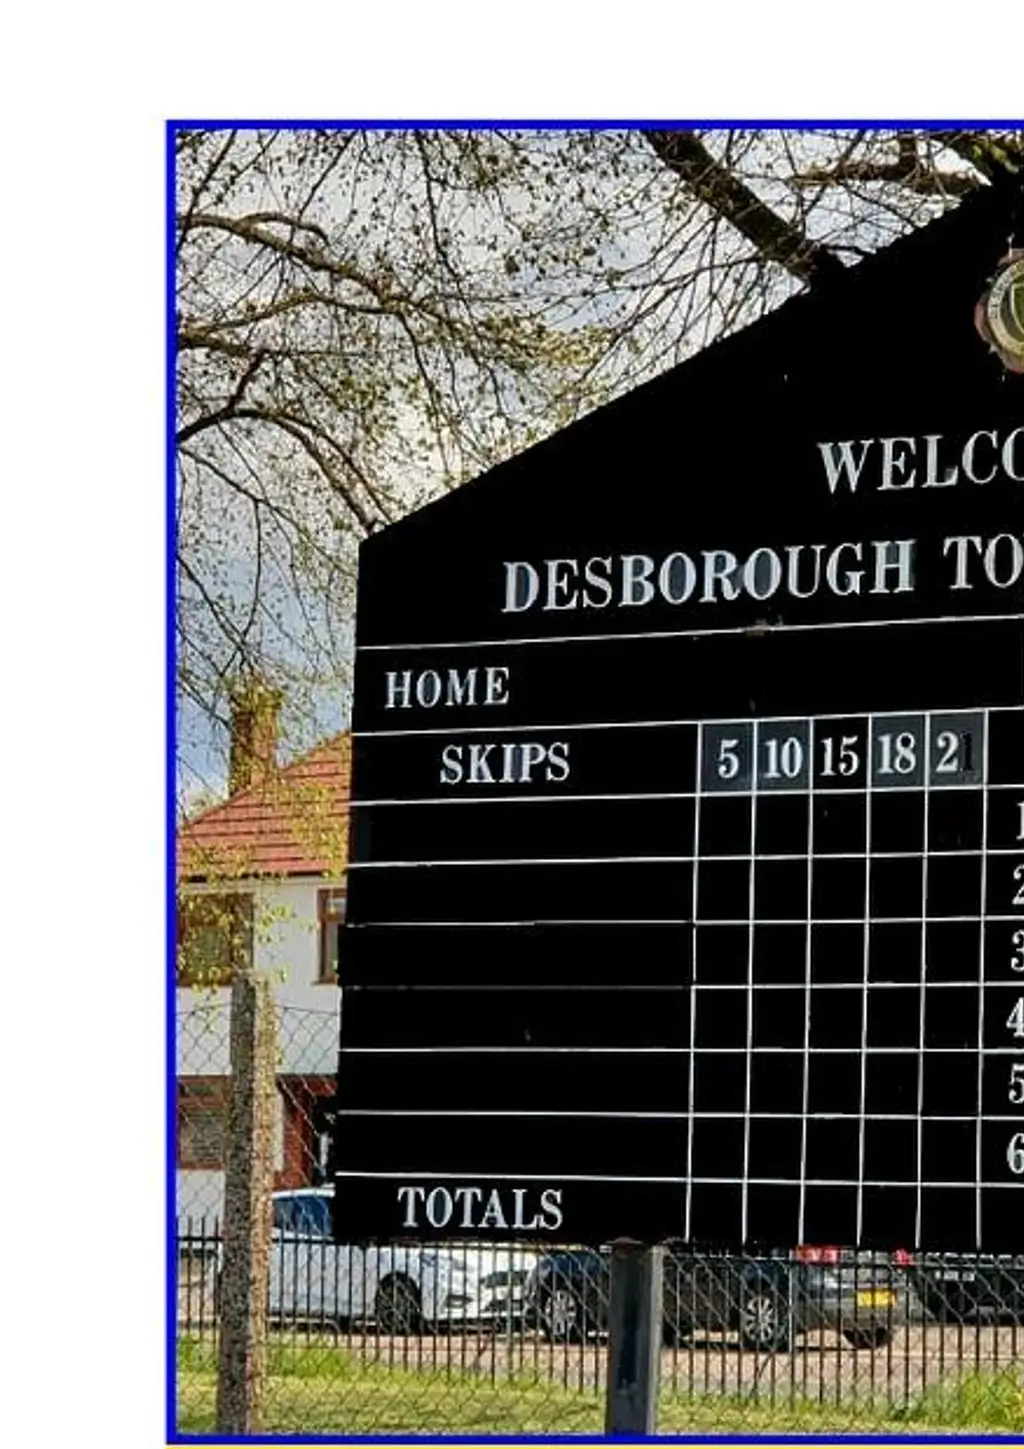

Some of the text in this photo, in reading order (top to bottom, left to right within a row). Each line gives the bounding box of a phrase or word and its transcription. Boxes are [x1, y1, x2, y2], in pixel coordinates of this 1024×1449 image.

[502, 541, 918, 614] DESBOROUGH
[385, 666, 509, 708] HOME
[440, 741, 570, 785] SKIPS
[718, 739, 739, 779] 5
[765, 738, 803, 779] 10
[821, 736, 859, 776] 15
[878, 733, 917, 774] 18
[397, 1187, 563, 1230] TOTALS
